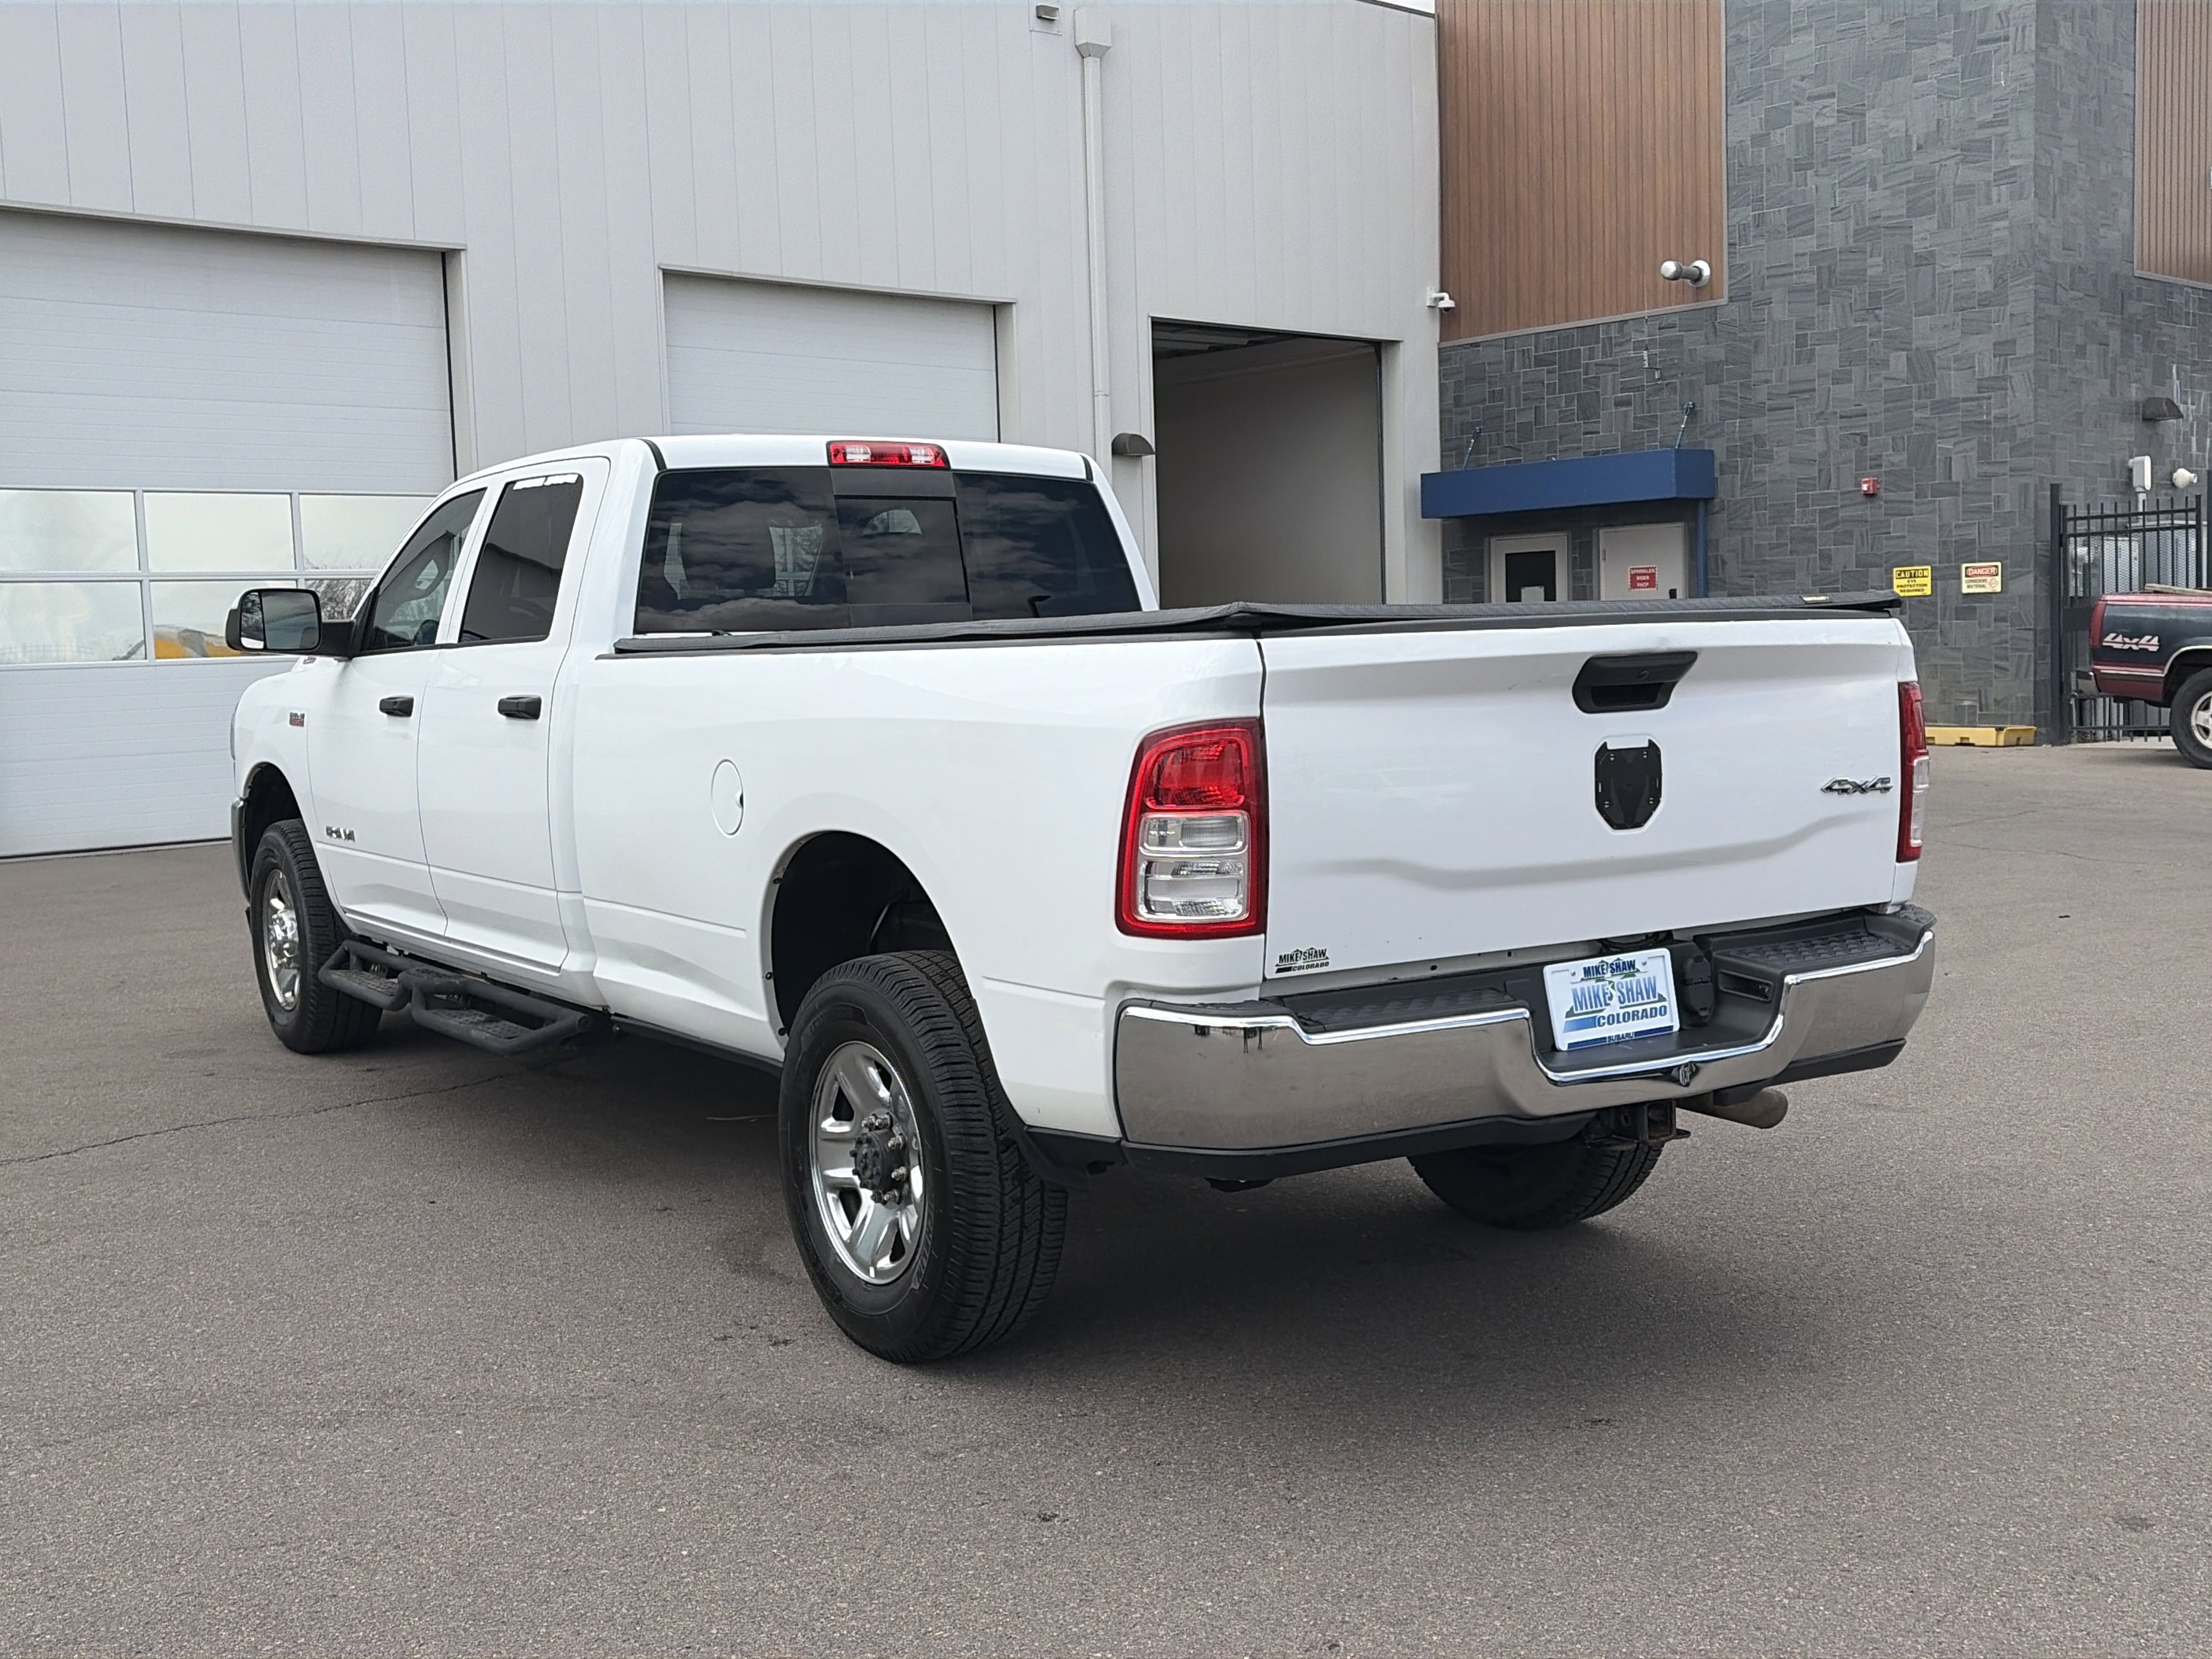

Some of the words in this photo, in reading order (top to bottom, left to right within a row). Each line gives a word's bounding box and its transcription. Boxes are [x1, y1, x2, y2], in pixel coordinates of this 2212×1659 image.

[1896, 569, 1928, 578] CAUTION
[1279, 952, 1300, 963] MIKE
[1302, 948, 1327, 961] SHAW
[1293, 961, 1329, 972] COLORADO
[1583, 964, 1606, 978] MIKE
[1610, 960, 1636, 974] SHAW
[1572, 981, 1611, 1012] MIKE
[1615, 976, 1657, 1005] SHAW
[1597, 1005, 1667, 1027] COLORADO
[1607, 1033, 1634, 1043] SUBARU
